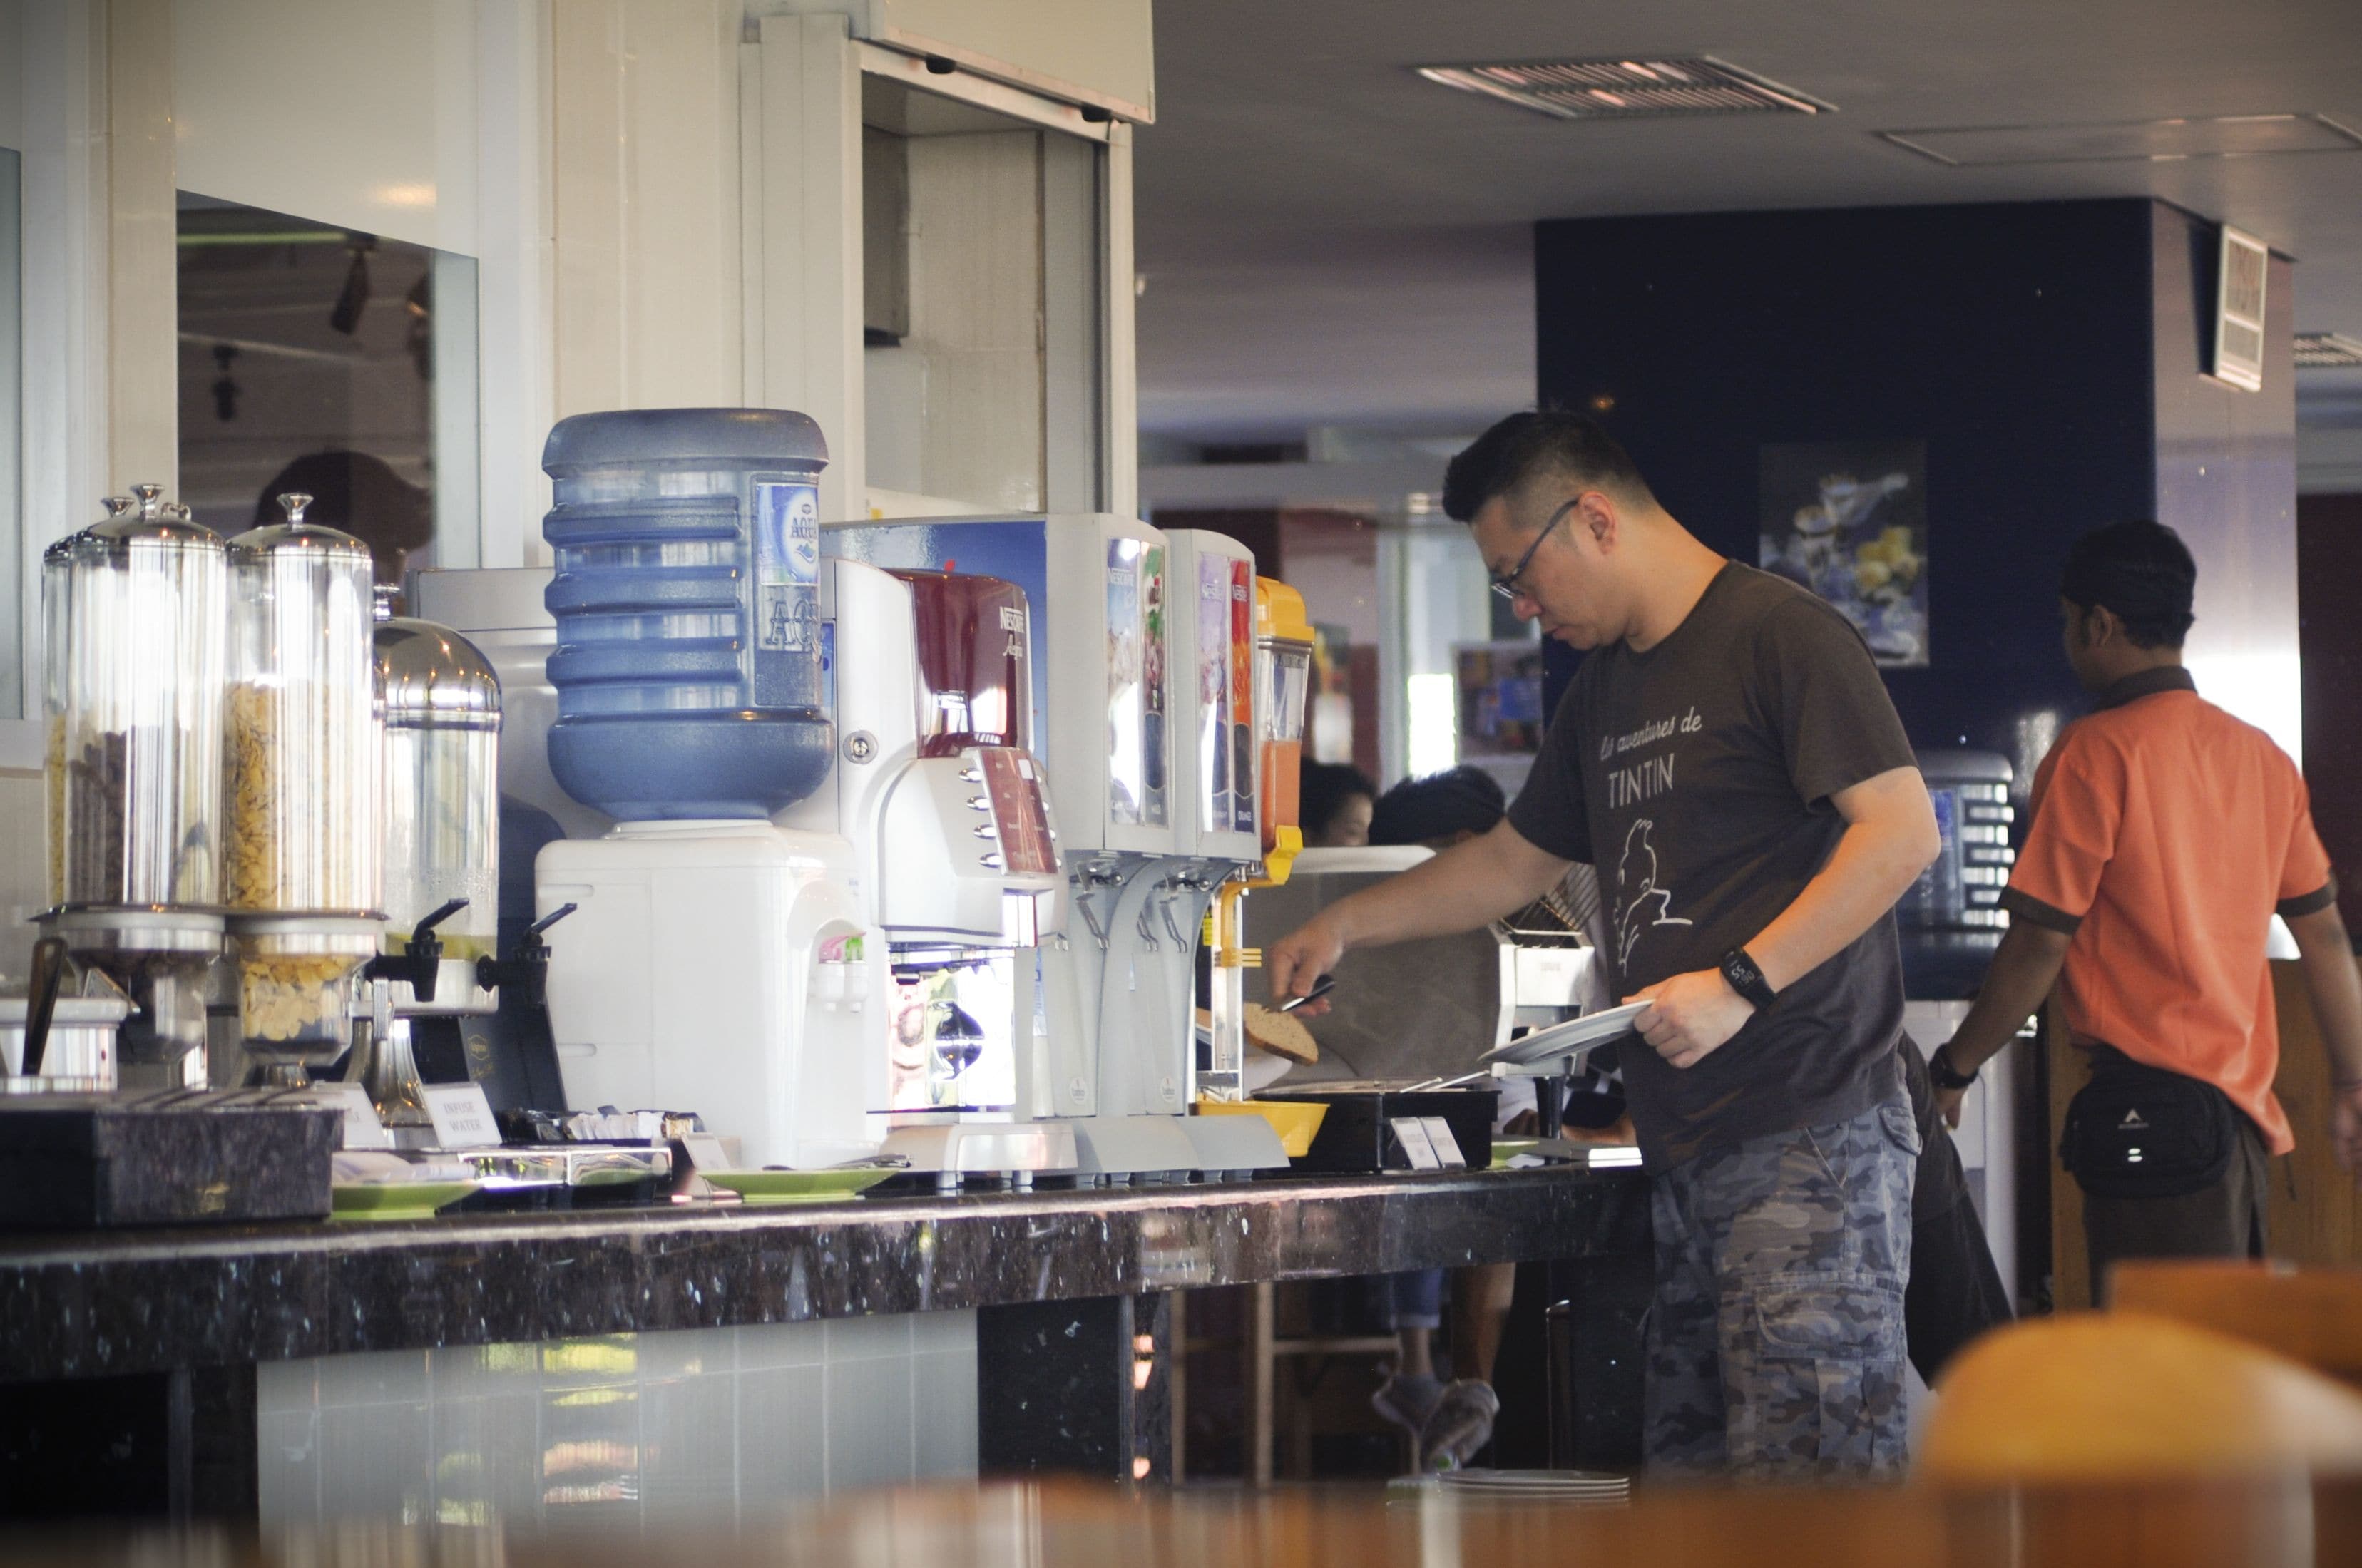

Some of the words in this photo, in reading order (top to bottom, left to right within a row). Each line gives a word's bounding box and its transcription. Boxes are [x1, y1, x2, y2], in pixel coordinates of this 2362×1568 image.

[1680, 706, 1703, 733] de
[1608, 753, 1675, 809] TINTIN
[443, 1102, 476, 1114] INFUSE
[449, 1119, 483, 1132] WATER
